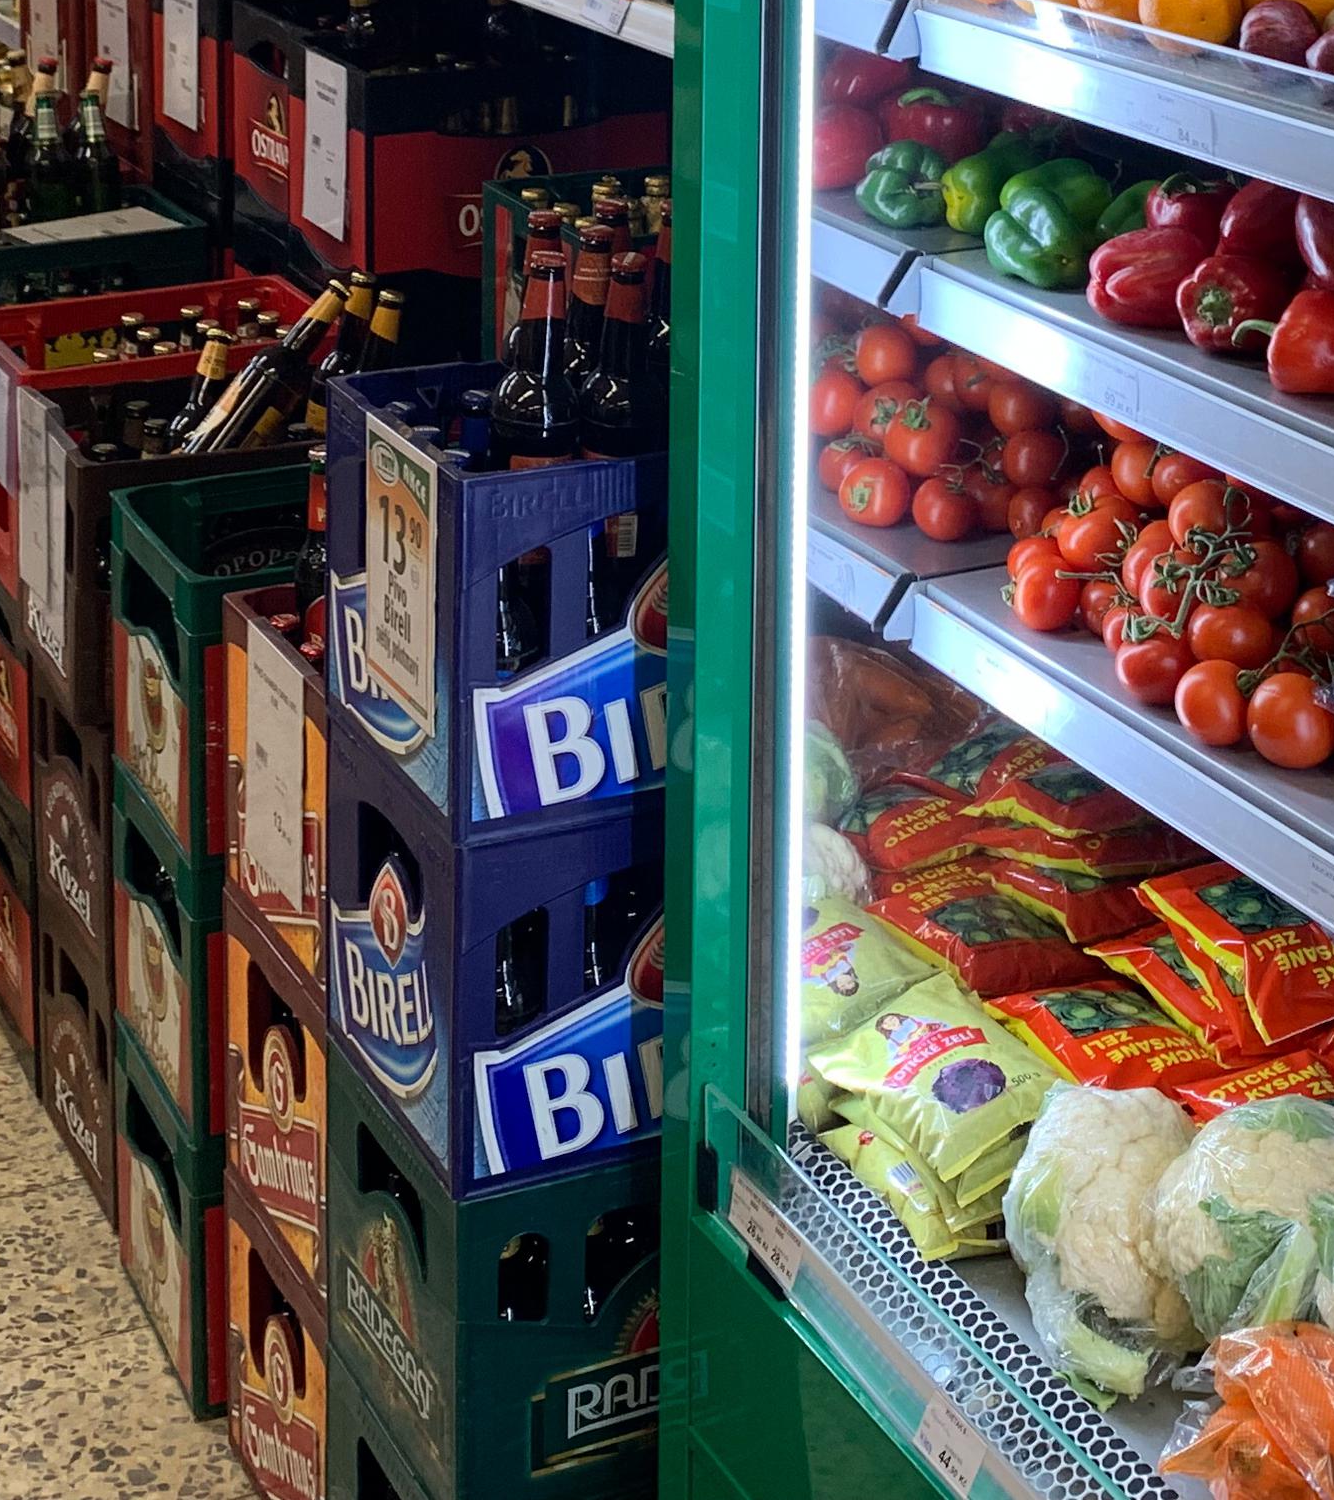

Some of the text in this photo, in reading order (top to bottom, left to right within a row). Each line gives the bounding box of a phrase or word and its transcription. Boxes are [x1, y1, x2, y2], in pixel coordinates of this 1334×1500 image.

[402, 463, 427, 505] AKCE
[379, 494, 422, 576] 13 90
[388, 570, 408, 608] Pivo
[383, 593, 412, 645] Birell
[49, 834, 91, 930] Kozel
[1251, 929, 1301, 961] ZELÍ
[344, 938, 434, 1047] BIRELL
[942, 1031, 975, 1050] ZELÍ
[1082, 1030, 1133, 1060] ZELÍ
[1148, 1049, 1217, 1073] TICKÉ
[1208, 1060, 1290, 1101] OTICKÉ
[54, 1071, 100, 1172] Kozel
[239, 1126, 317, 1206] Gambrinus
[346, 1265, 436, 1421] RADEGAST
[241, 1404, 317, 1500] Gambrinus
